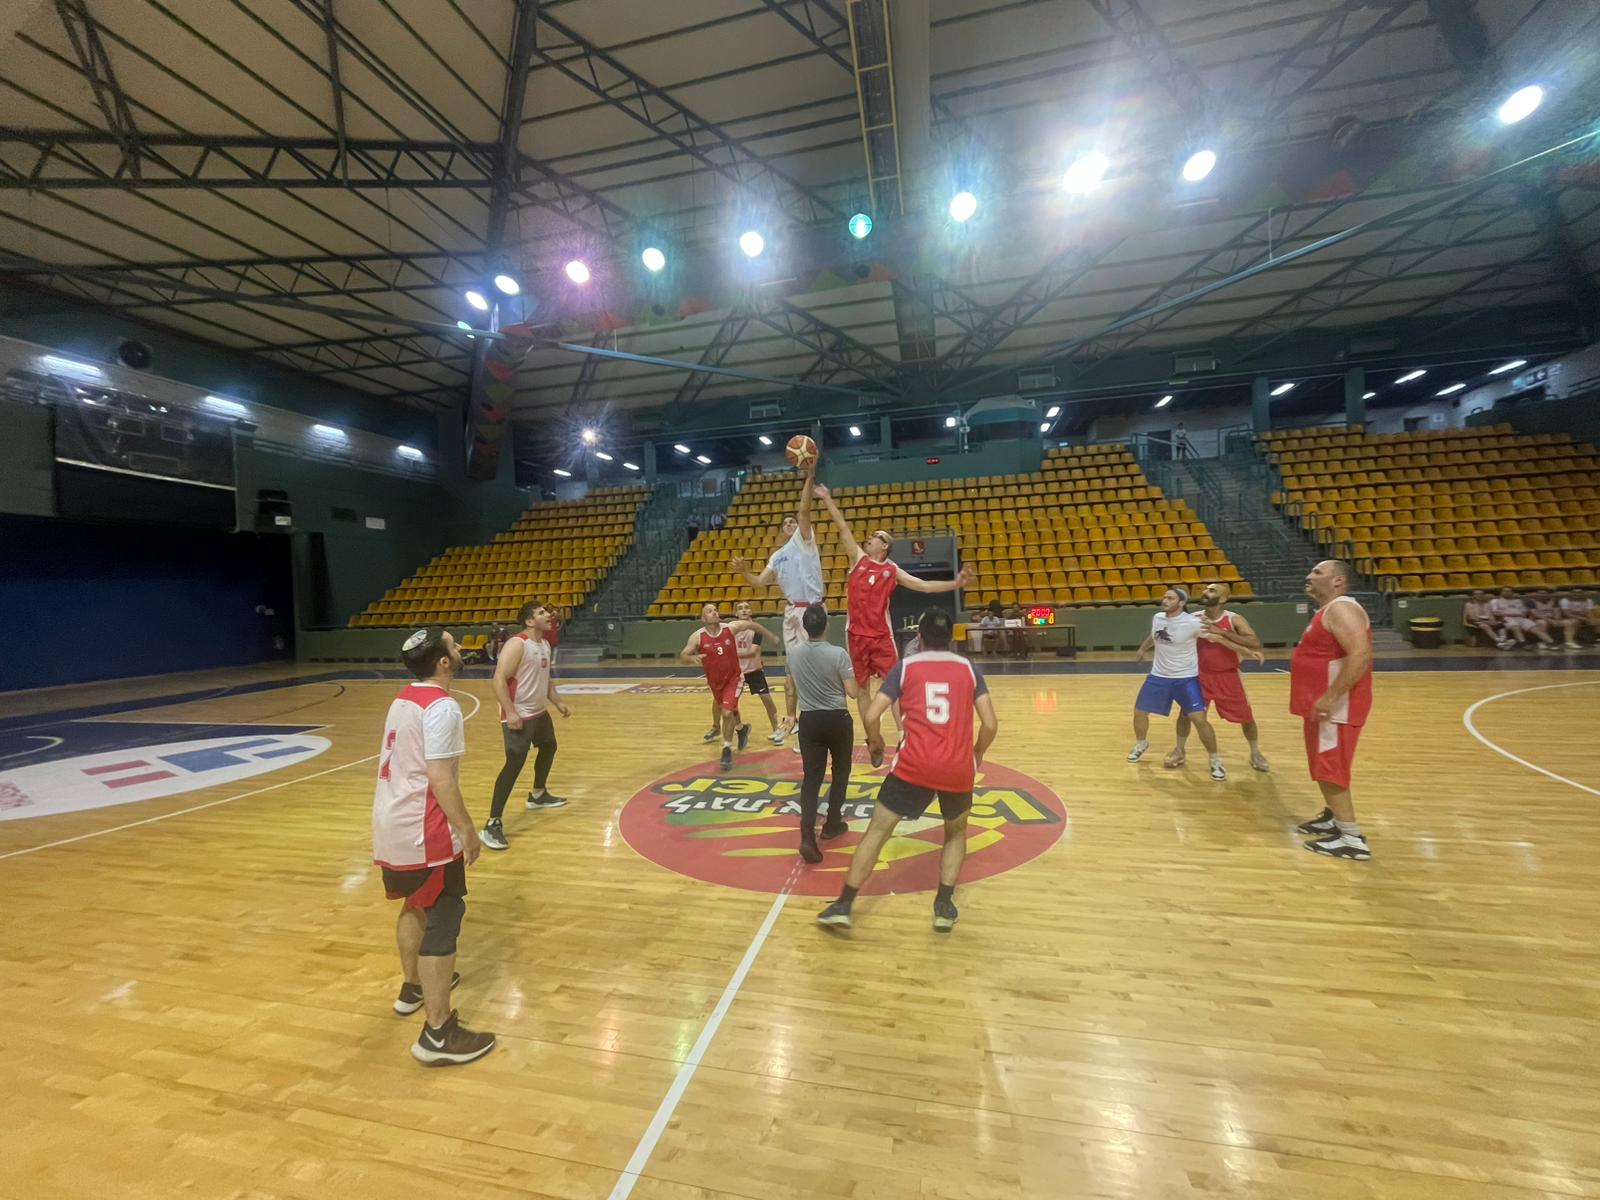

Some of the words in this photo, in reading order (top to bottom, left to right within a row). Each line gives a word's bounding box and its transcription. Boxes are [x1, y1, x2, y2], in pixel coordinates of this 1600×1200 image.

[868, 574, 875, 586] 4
[716, 646, 724, 656] 3
[925, 681, 950, 725] 5
[661, 778, 1048, 821] Wnner
[665, 795, 772, 814] ליגת
